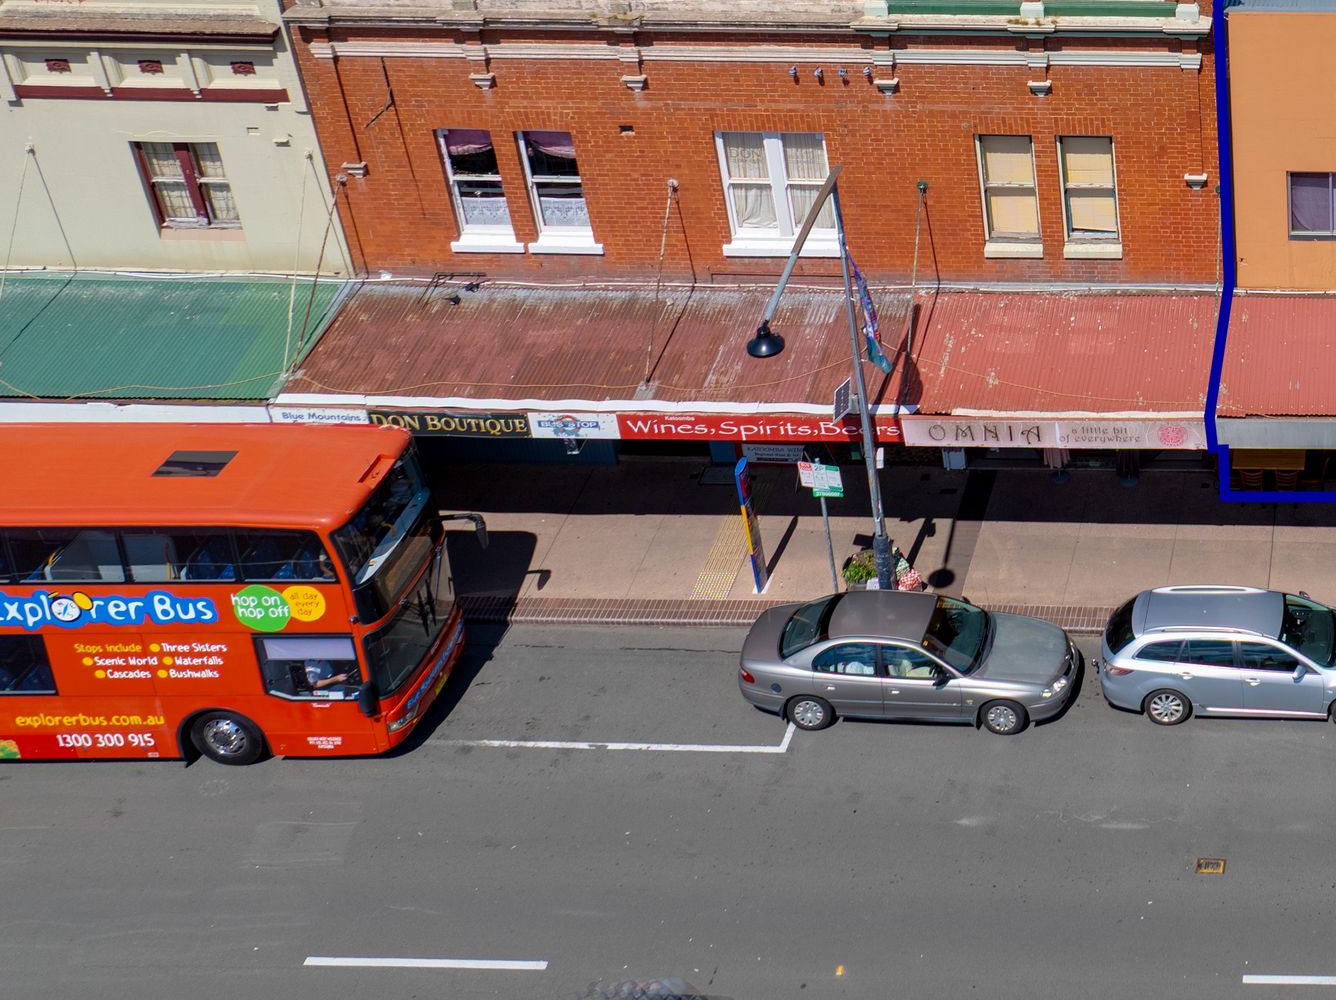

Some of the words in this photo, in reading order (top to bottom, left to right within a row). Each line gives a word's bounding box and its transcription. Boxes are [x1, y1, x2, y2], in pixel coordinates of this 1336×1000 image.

[282, 412, 304, 420] Blue
[308, 412, 360, 421] Mountains
[370, 413, 420, 430] DON
[425, 415, 528, 435] BOUTIQUE
[626, 420, 715, 435] Wines,
[719, 420, 818, 441] Spirits,
[928, 424, 1041, 444] OMNIA
[1081, 426, 1109, 435] little
[1113, 426, 1128, 435] bit
[1059, 434, 1070, 444] of
[1074, 434, 1141, 444] everywhere
[231, 593, 258, 607] hop
[261, 596, 281, 606] on
[153, 595, 213, 620] Bus
[237, 605, 265, 619] hop
[269, 605, 289, 617] off
[298, 608, 312, 616] day
[74, 643, 103, 654] Stops
[105, 643, 142, 653] include
[161, 643, 190, 652] Three
[191, 642, 228, 653] Sisters
[94, 656, 127, 666] Scenic
[128, 656, 158, 666] World
[174, 656, 224, 666] Waterfalls
[106, 669, 152, 679] Cascades
[169, 669, 220, 679] Bushwalks
[15, 713, 165, 728] explorerbus.com.au
[56, 733, 92, 747] 1300
[94, 732, 125, 747] 300
[127, 732, 156, 747] 915
